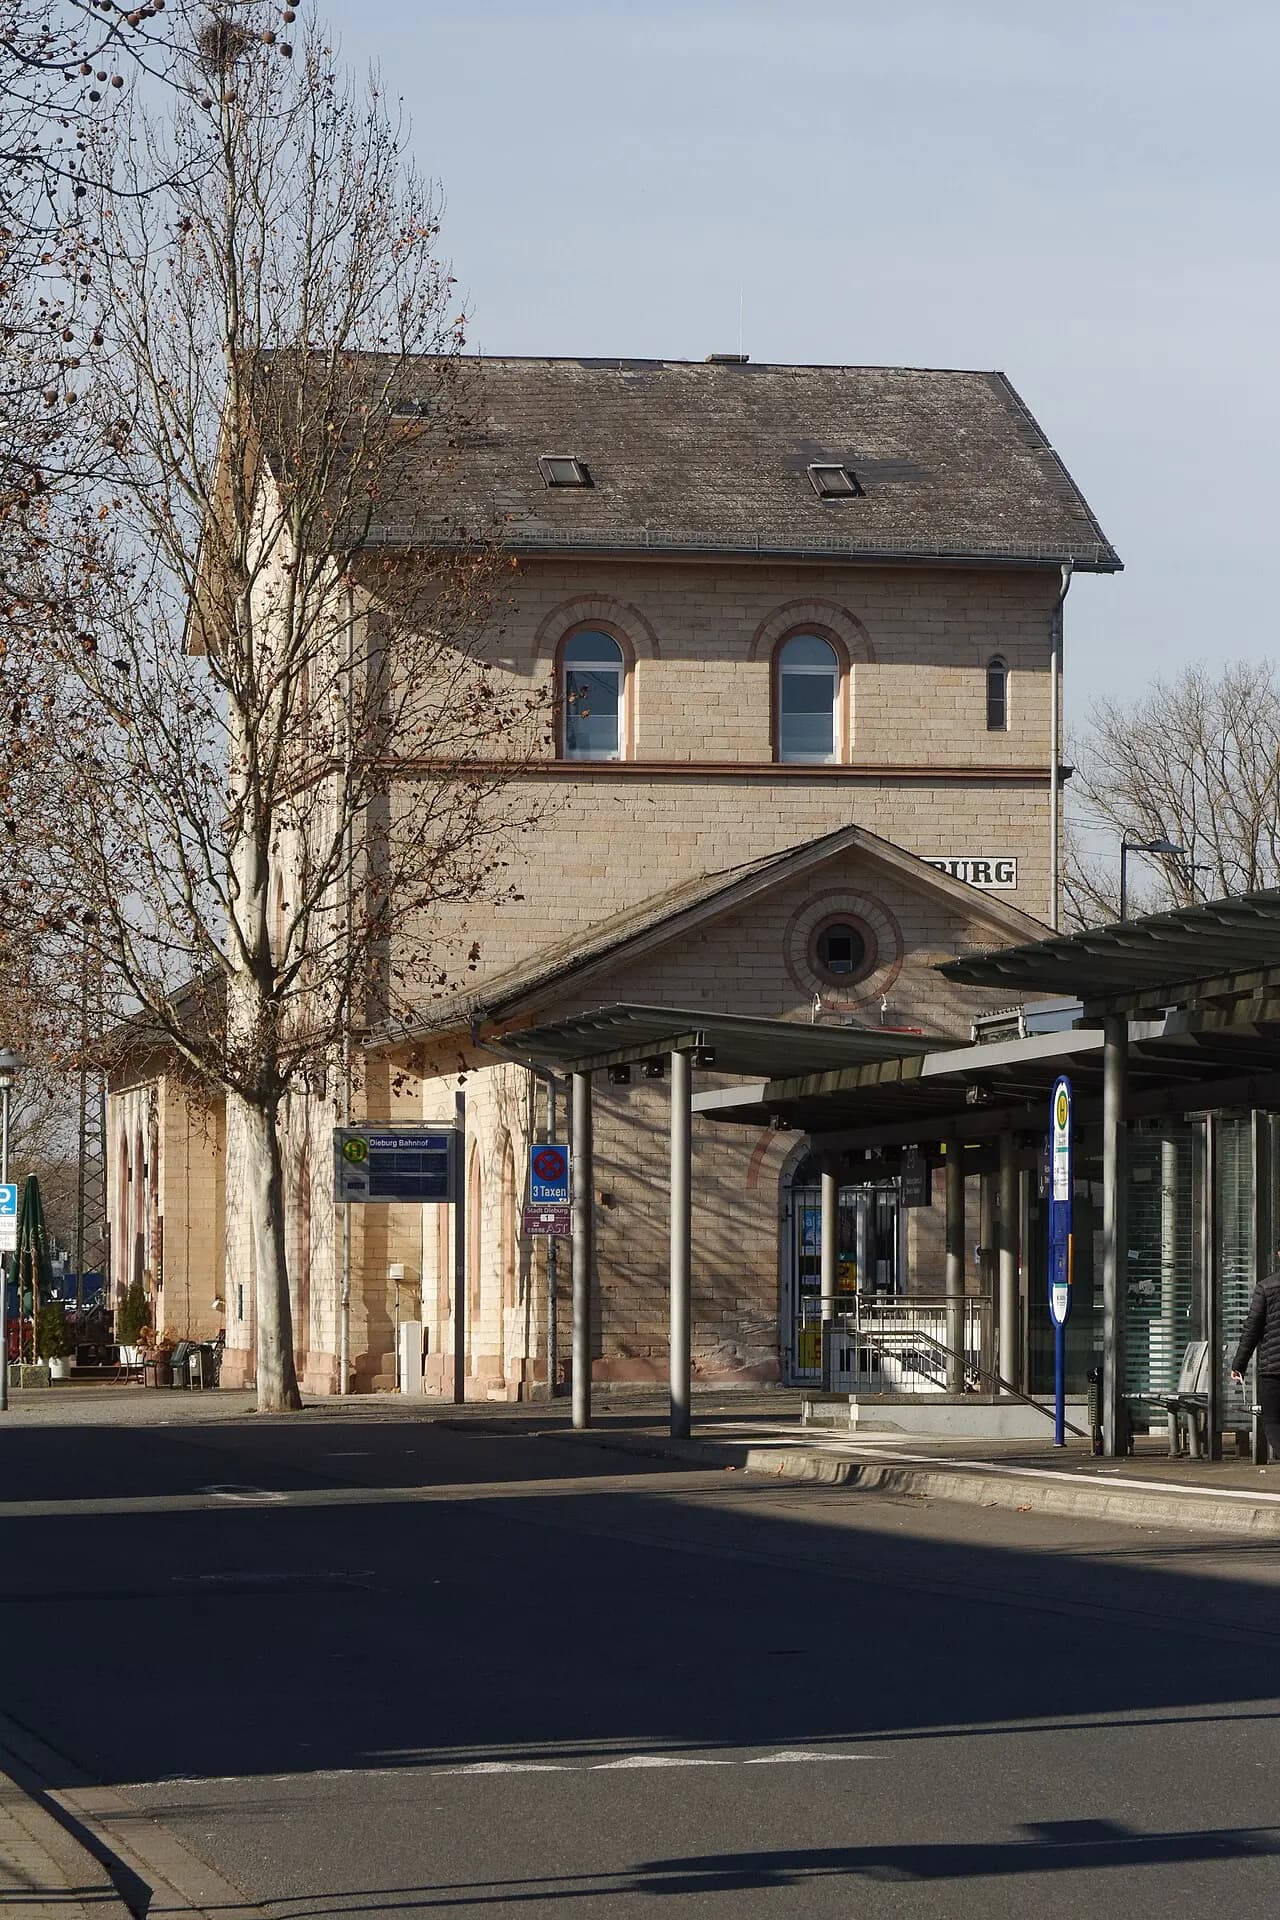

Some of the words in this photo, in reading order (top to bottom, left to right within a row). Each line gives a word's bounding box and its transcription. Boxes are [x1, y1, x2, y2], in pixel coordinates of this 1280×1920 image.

[369, 1139, 398, 1148] Dieburg
[398, 1139, 429, 1148] Bahnhof
[533, 1186, 539, 1197] 3
[540, 1186, 567, 1197] Taxen
[544, 1207, 568, 1215] Dieburg
